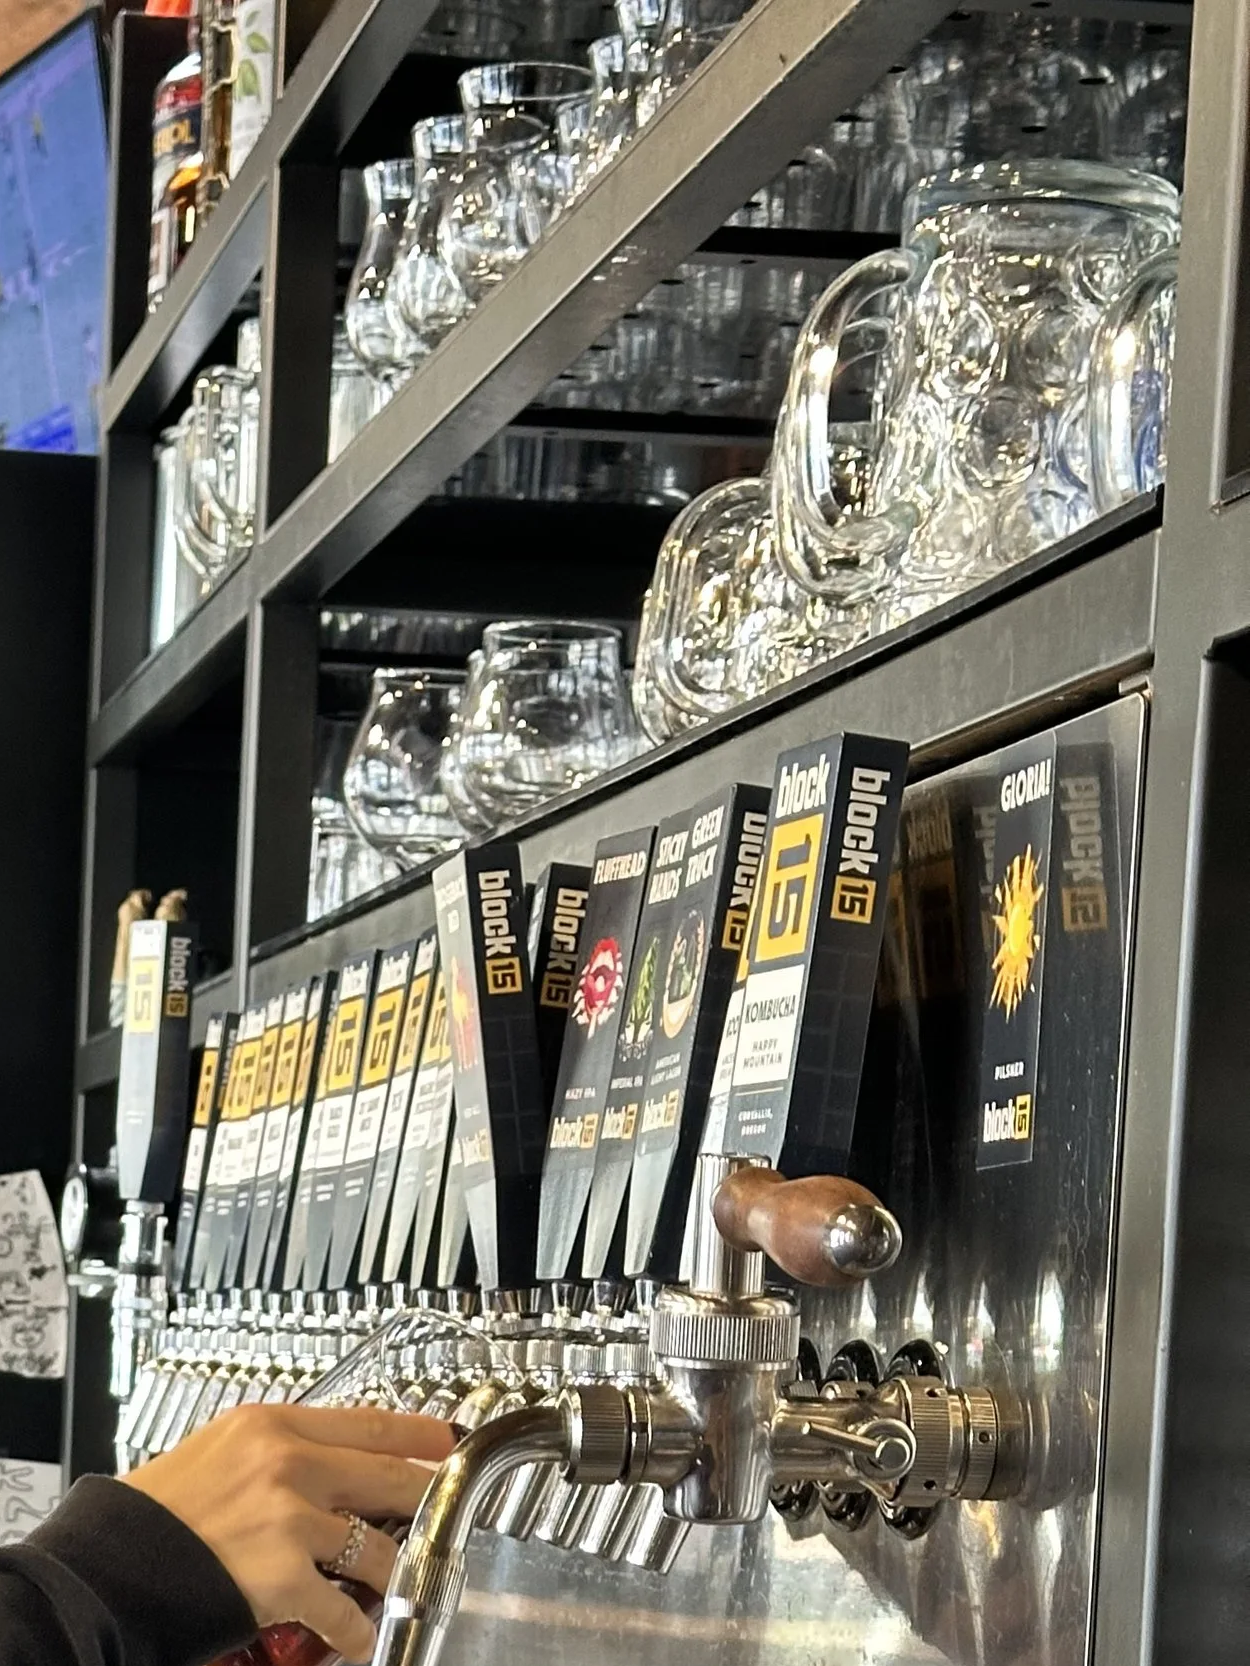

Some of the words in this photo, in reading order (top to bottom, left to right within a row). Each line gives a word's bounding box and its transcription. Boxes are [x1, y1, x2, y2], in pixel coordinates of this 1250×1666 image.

[775, 753, 831, 819] block
[1001, 758, 1052, 813] GLORIA!
[691, 805, 725, 849] GREEN
[593, 850, 648, 885] FLUFFHEAD
[685, 844, 718, 888] TRUCK
[764, 829, 816, 946] 15
[744, 995, 797, 1025] KOMBUCHA
[333, 1006, 359, 1078] 15
[368, 999, 398, 1072] 15
[752, 1038, 779, 1053] HAPPY
[742, 1051, 784, 1070] MOUNTAIN
[993, 1061, 1025, 1081] PILSNER
